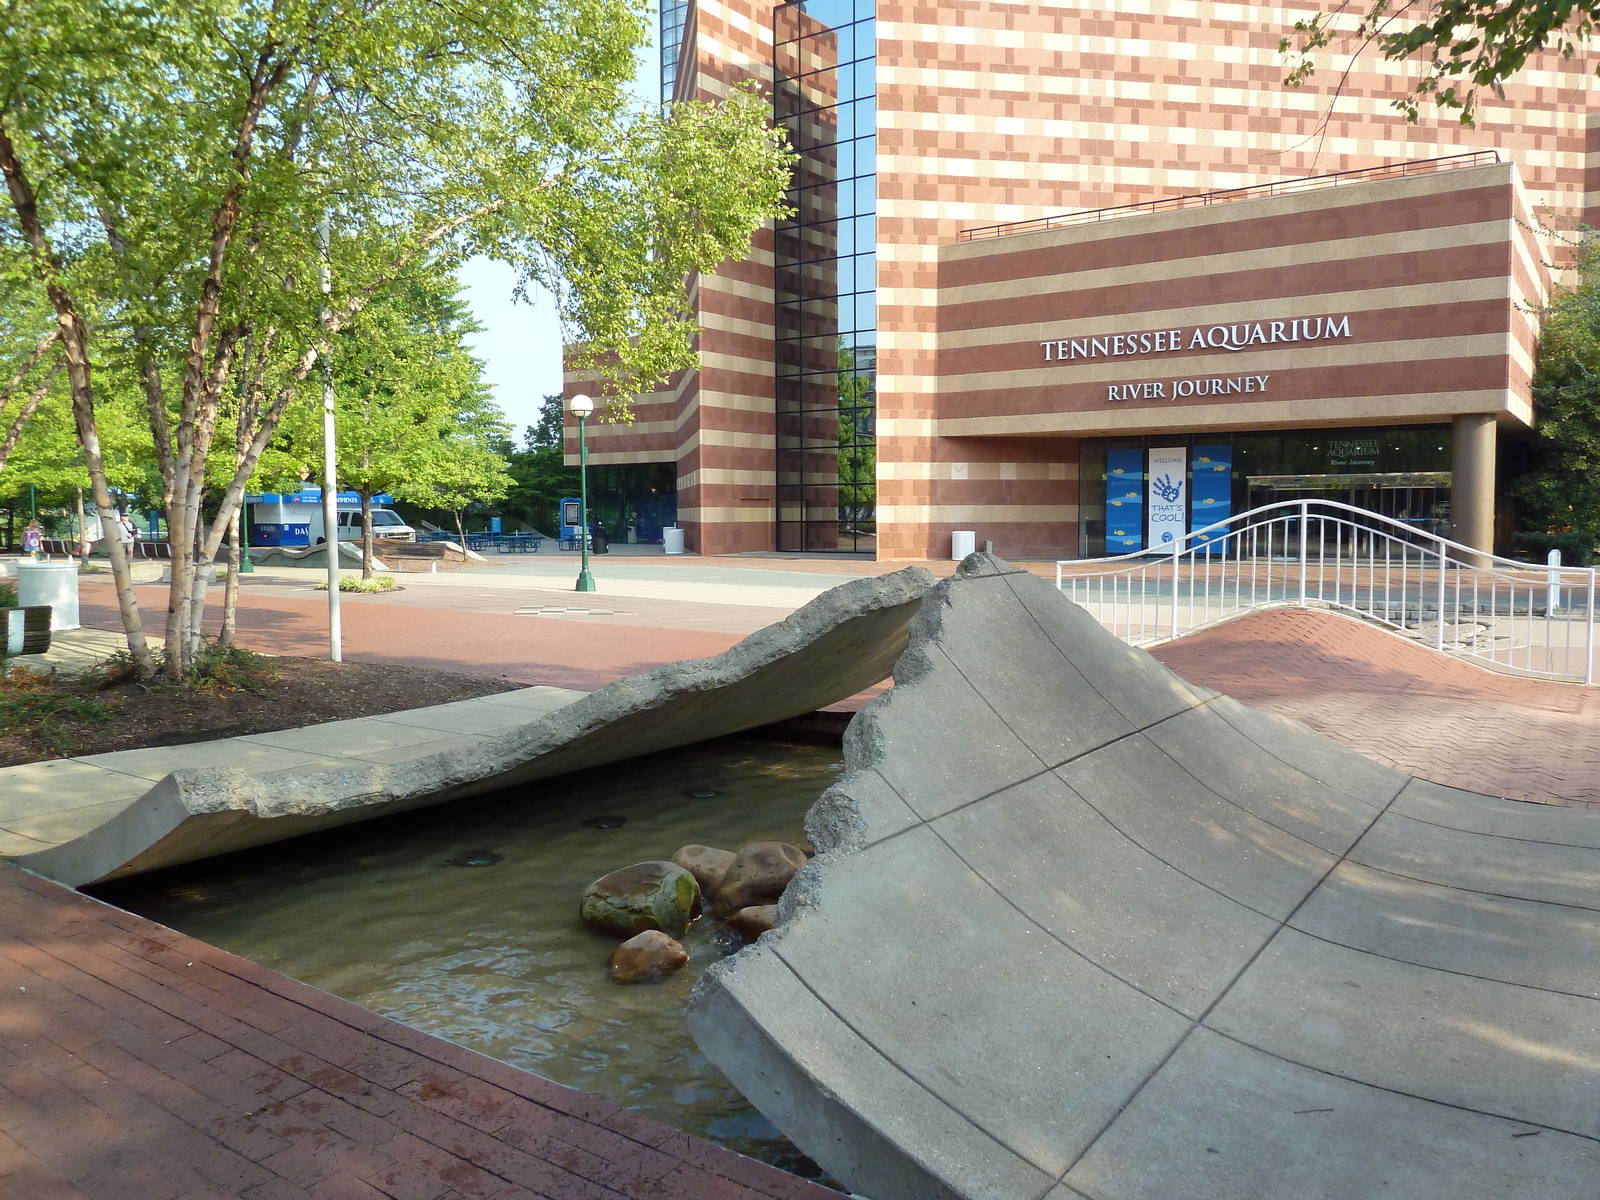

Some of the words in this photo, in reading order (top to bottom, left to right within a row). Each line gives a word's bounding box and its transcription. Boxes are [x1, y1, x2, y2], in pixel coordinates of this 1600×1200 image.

[1040, 329, 1183, 362] TENNESSEE
[1187, 314, 1353, 351] AQUARIUM
[1107, 381, 1166, 401] RIVER
[1171, 375, 1270, 401] JOURNEY
[1327, 440, 1378, 450] TENNESSEE
[1326, 448, 1380, 458] AQUARIUM
[1349, 459, 1375, 467] Journey
[1151, 504, 1183, 512] THAT'S
[1151, 512, 1185, 523] COOL!
